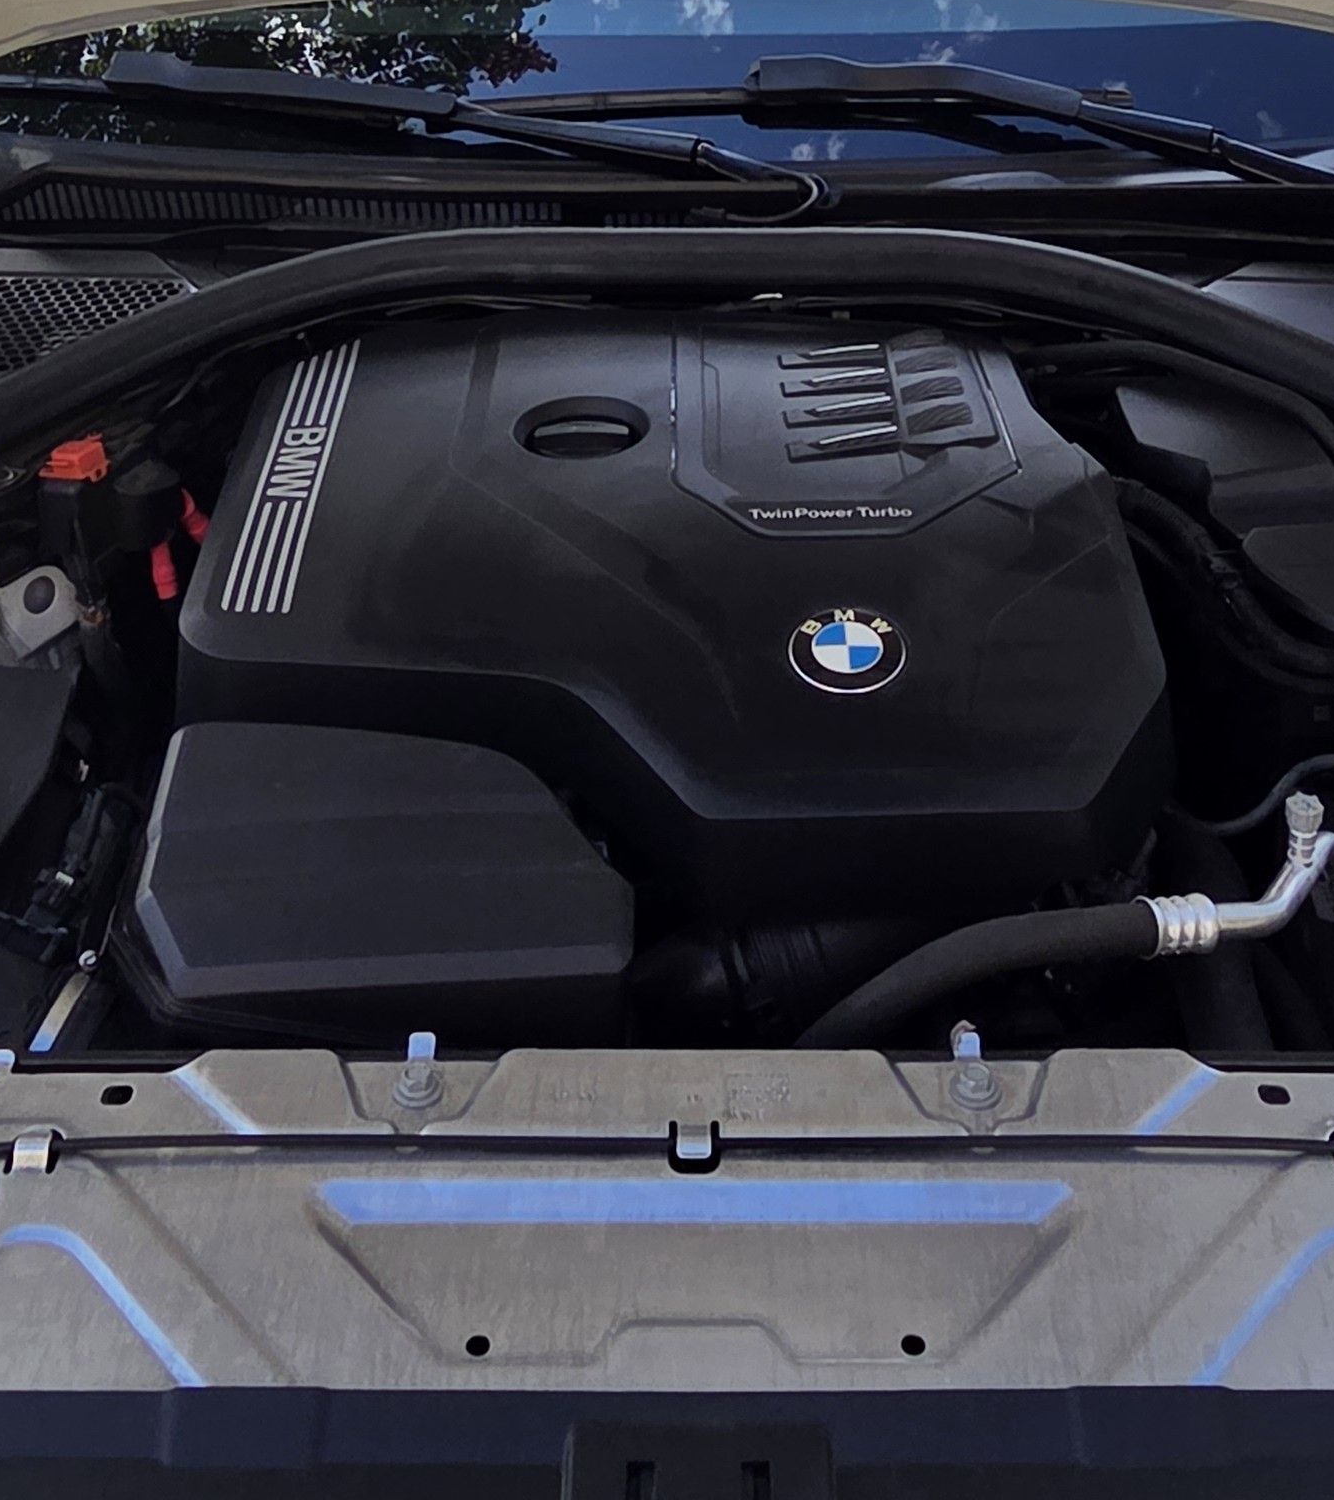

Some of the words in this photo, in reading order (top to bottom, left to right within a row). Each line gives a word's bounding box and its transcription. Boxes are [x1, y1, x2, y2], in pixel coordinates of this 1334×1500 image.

[266, 427, 327, 498] BMW
[748, 506, 854, 520] TwinPower
[855, 505, 913, 518] Turbo
[800, 609, 893, 635] BMW
